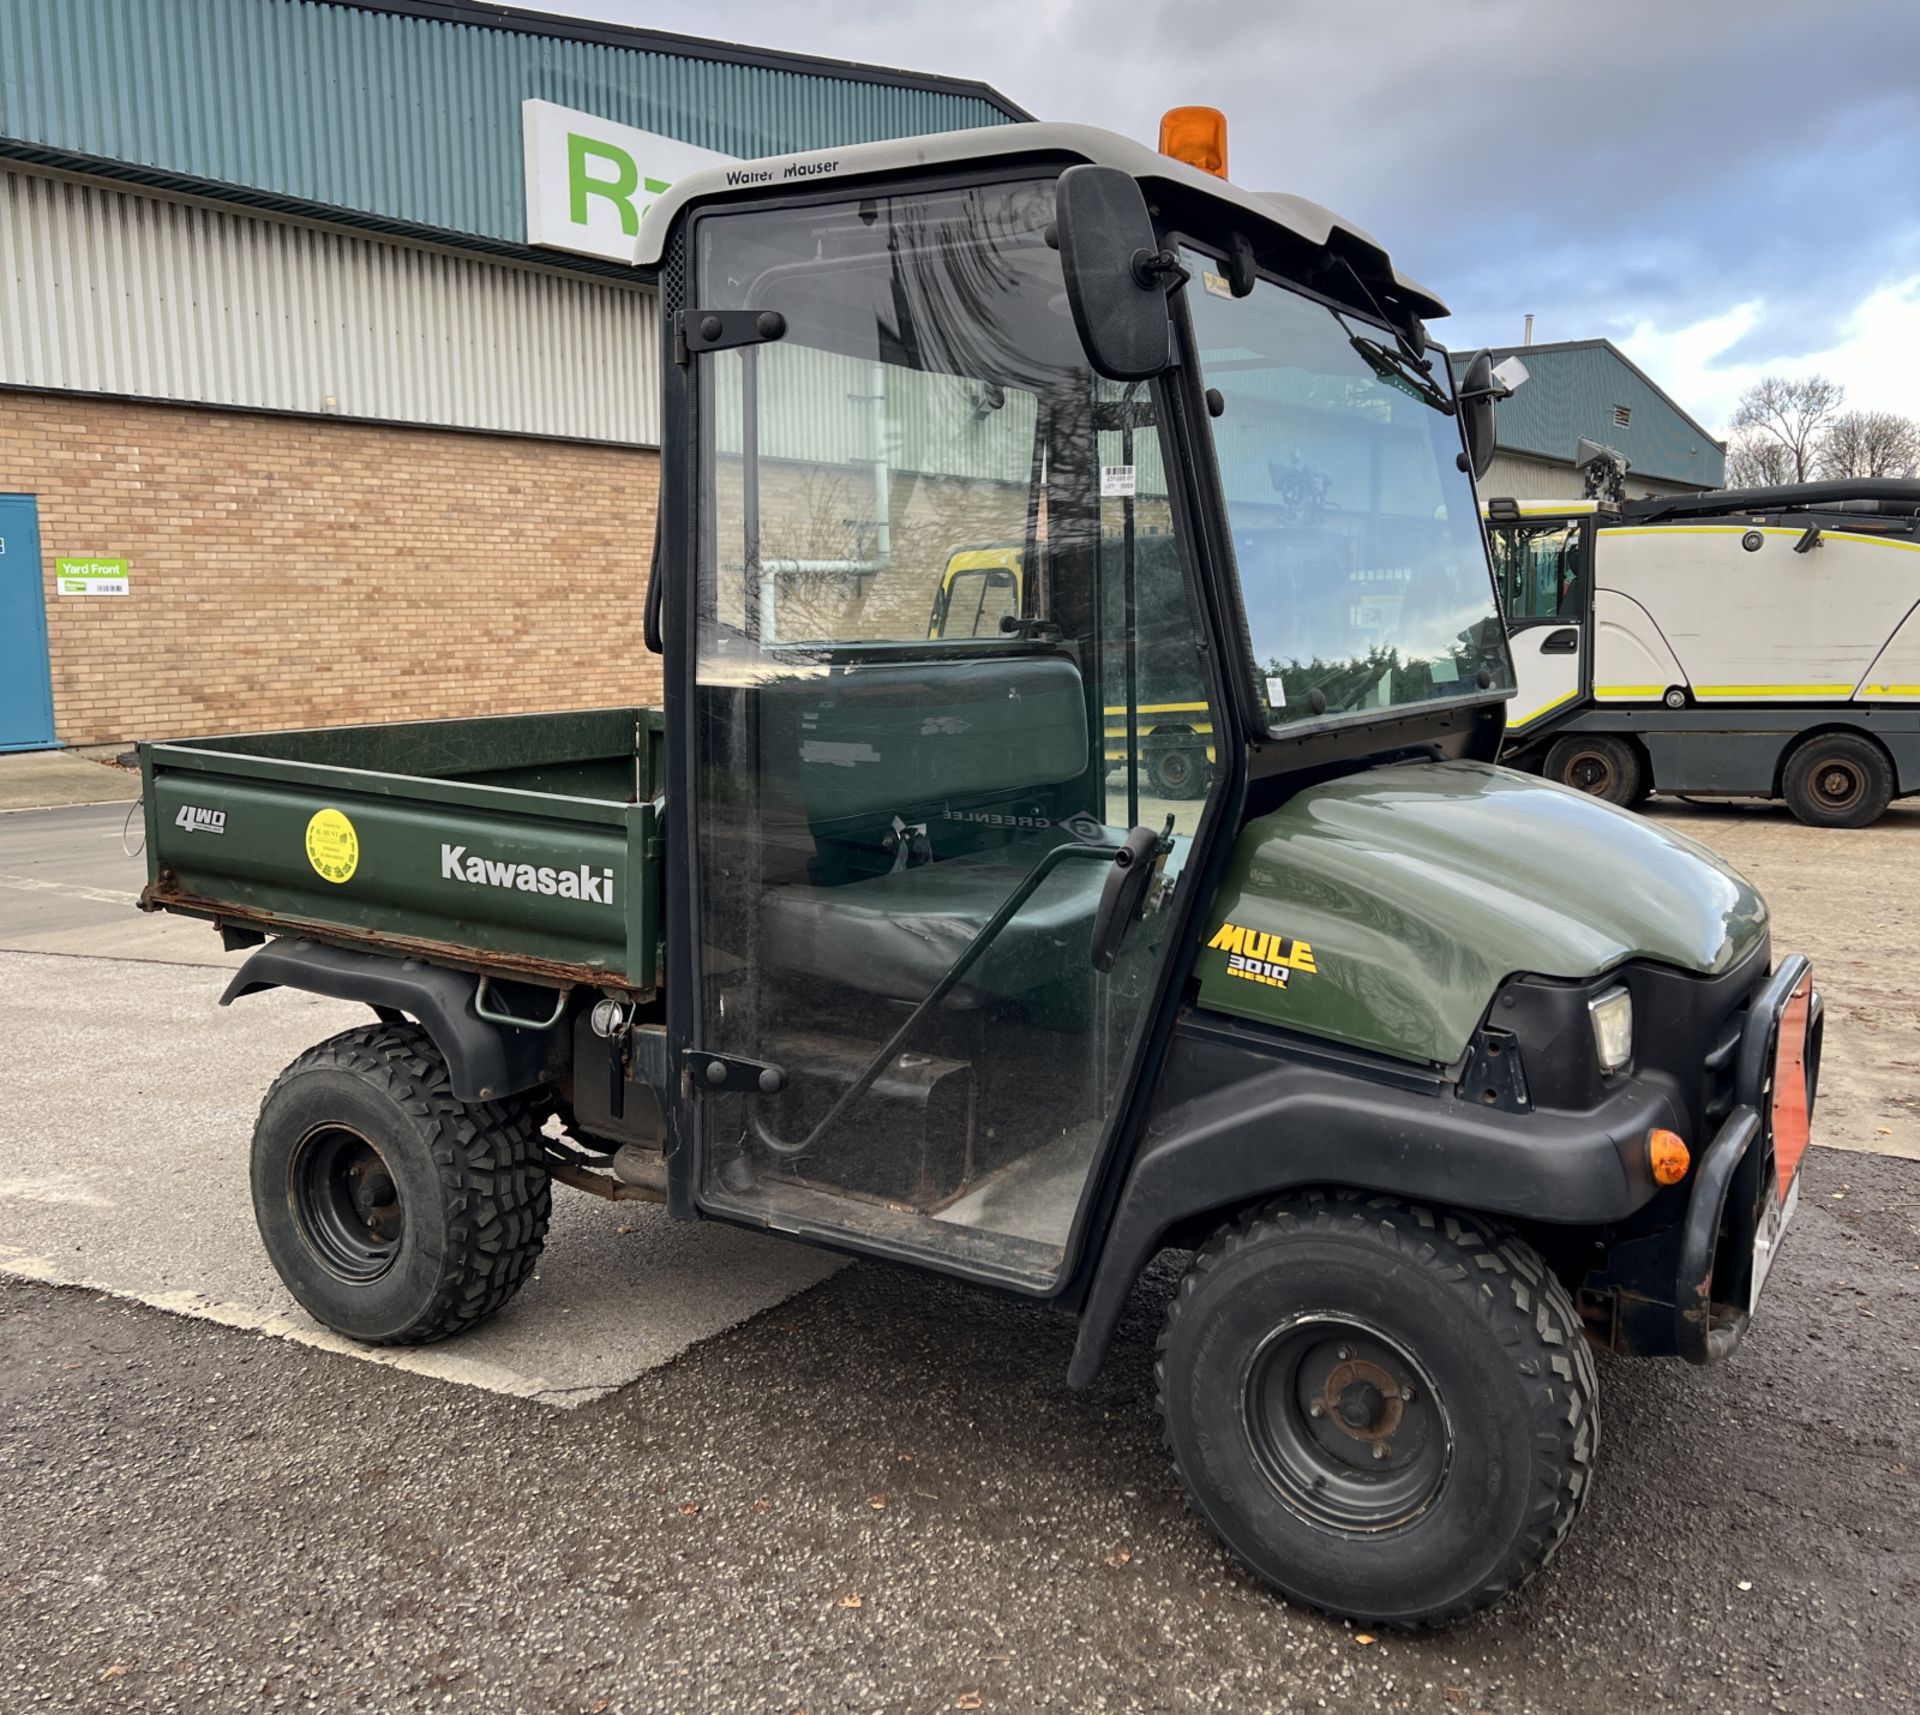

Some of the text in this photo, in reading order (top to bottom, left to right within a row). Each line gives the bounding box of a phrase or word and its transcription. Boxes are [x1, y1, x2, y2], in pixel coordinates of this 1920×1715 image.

[783, 160, 839, 178] Mauser
[63, 563, 121, 575] Yard Front
[175, 804, 226, 832] 4WD
[441, 843, 614, 905] Kawasaki
[1207, 923, 1318, 974] MULE
[1226, 966, 1287, 990] DIESEL
[1228, 954, 1290, 982] 3010
